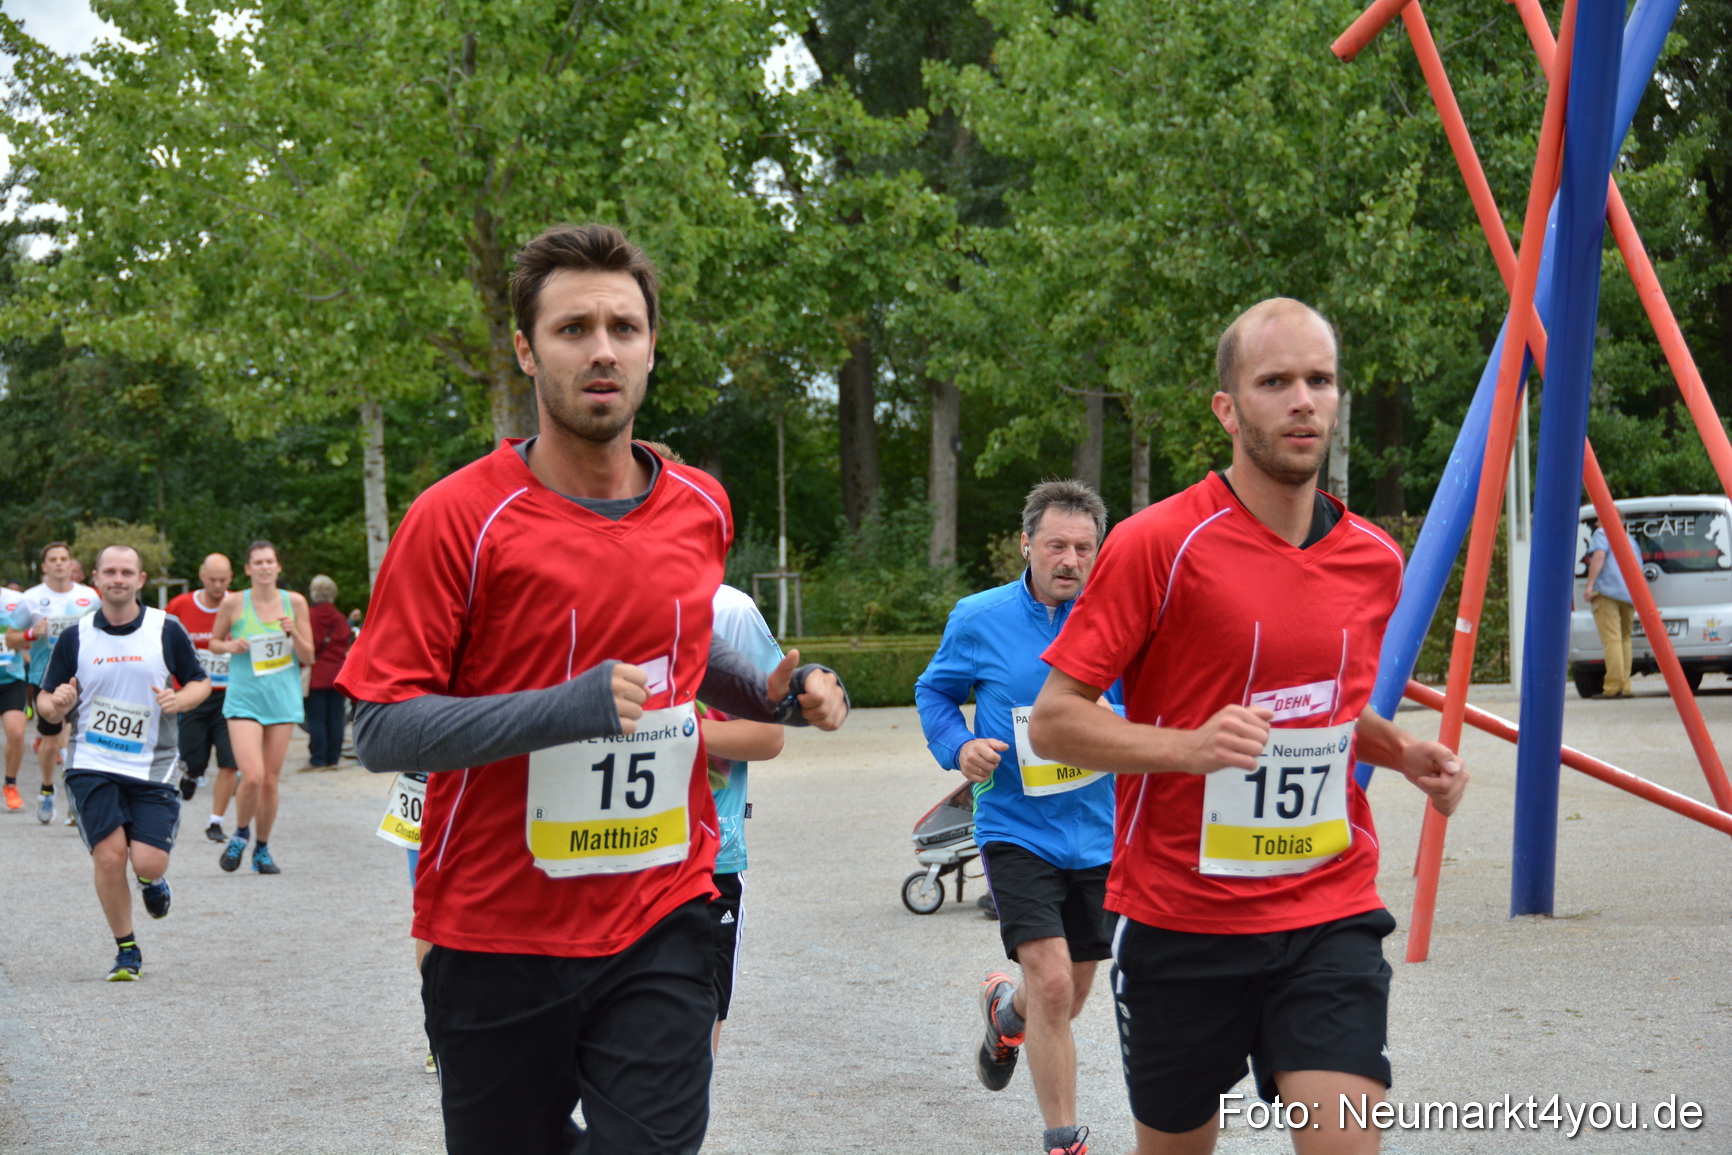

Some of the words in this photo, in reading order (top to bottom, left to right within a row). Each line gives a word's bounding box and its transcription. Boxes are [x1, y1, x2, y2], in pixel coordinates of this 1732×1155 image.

[265, 641, 283, 658] 37
[1274, 693, 1312, 712] DEHN
[92, 710, 144, 739] 2694
[97, 736, 130, 751] Andreas
[602, 725, 678, 744] Neumarkt
[1272, 743, 1336, 758] Neumarkt
[591, 751, 656, 810] 15
[1056, 767, 1083, 781] Max
[1244, 764, 1331, 819] 157
[395, 822, 421, 841] Christo
[569, 826, 659, 853] Matthias
[1252, 834, 1313, 856] Tobias
